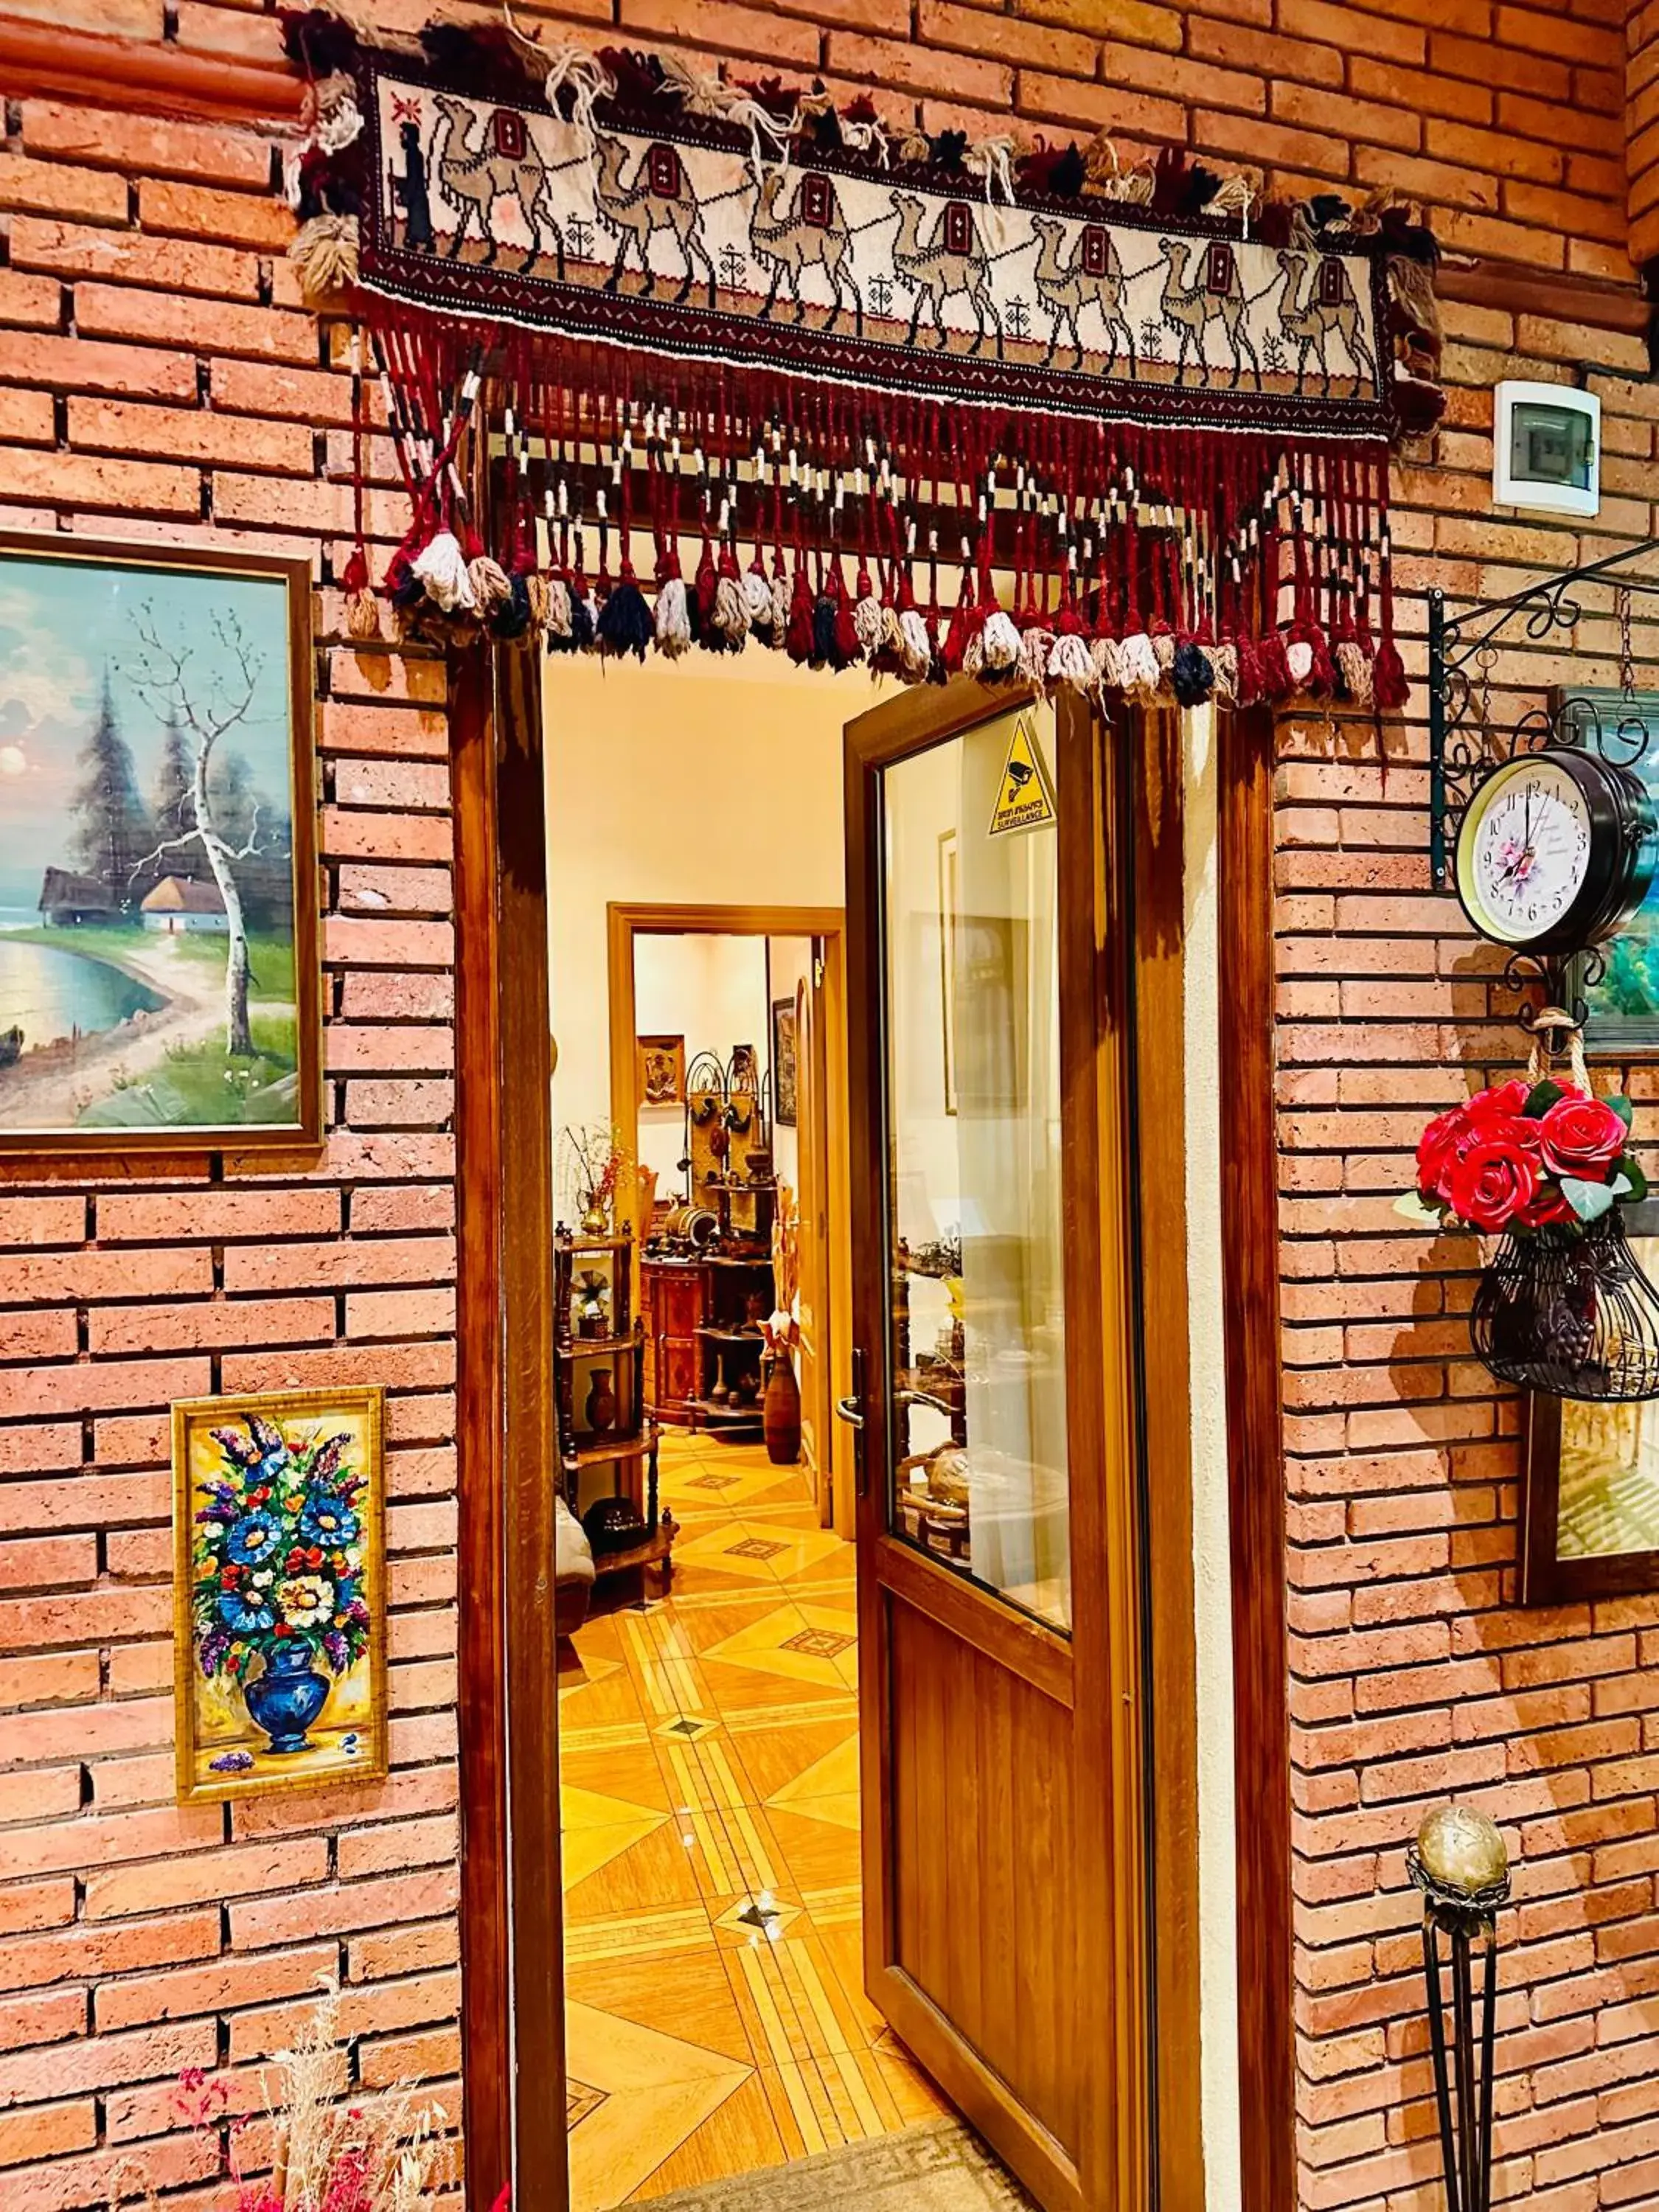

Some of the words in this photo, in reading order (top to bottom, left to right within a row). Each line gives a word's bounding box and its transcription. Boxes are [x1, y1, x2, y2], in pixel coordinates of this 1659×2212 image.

[1506, 793, 1516, 811] 11
[1555, 784, 1560, 801] 1
[1570, 800, 1579, 819] 2
[1490, 818, 1500, 836] 10
[1577, 832, 1586, 852] 3
[1484, 851, 1492, 869] 9
[1570, 865, 1578, 885] 4
[1490, 880, 1499, 899] 8
[1507, 898, 1514, 917] 7
[1552, 891, 1562, 910] 5
[1528, 902, 1537, 922] 6
